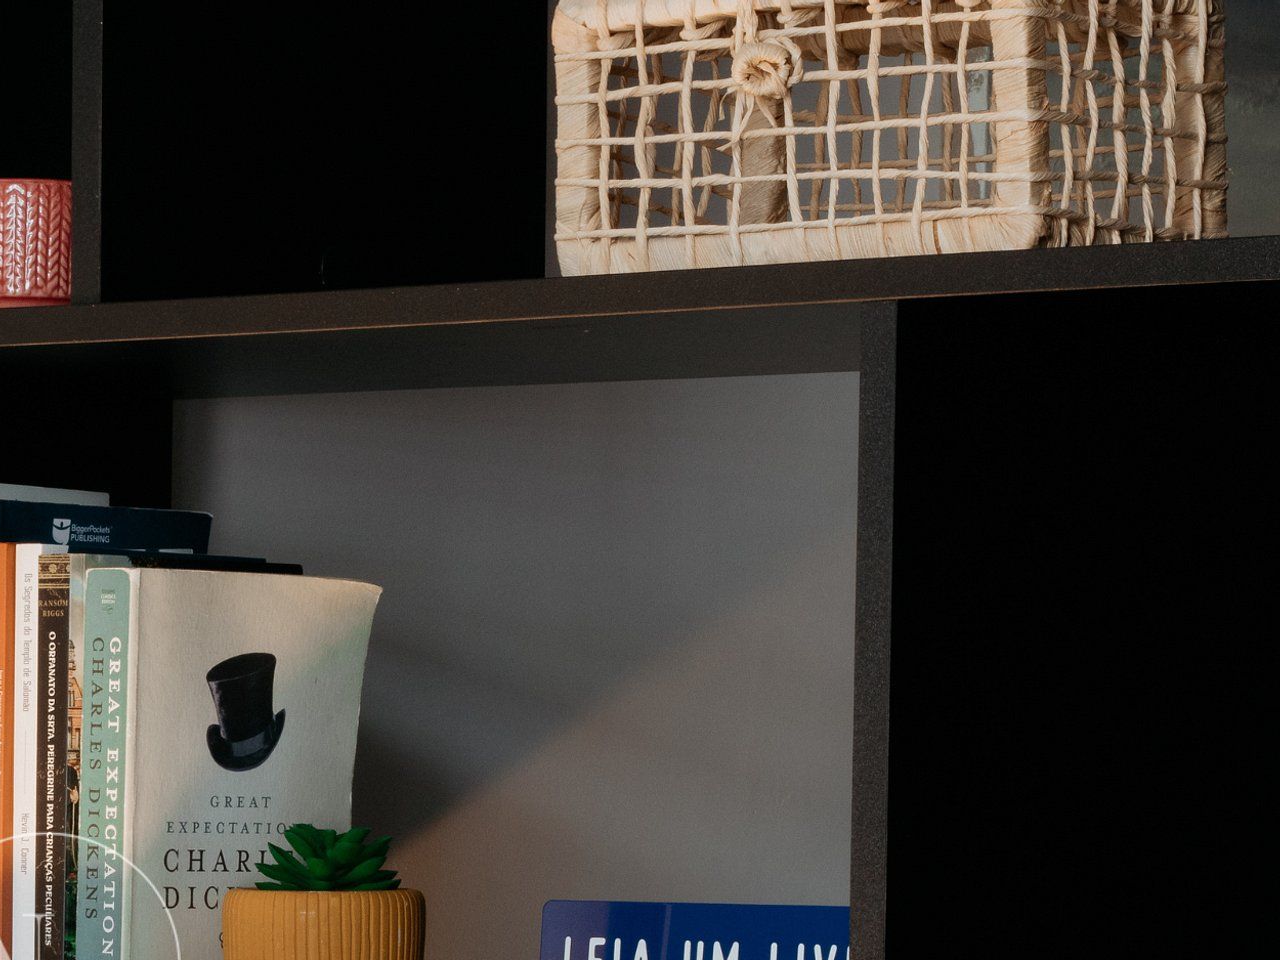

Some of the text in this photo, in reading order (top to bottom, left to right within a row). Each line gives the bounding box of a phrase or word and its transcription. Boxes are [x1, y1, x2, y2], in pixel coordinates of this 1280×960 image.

[70, 533, 110, 543] PUBLISHING
[21, 585, 33, 623] Segredos
[42, 609, 65, 618] RIGGS
[106, 636, 122, 734] GREAT
[44, 631, 57, 946] O ORFANATO DA SRTA. PEREGRINE PARA CRIANÇAS PECULIARES
[85, 637, 105, 920] CHARLES DICKENS
[210, 795, 272, 808] GREAT
[166, 821, 287, 834] EXPECTATIO
